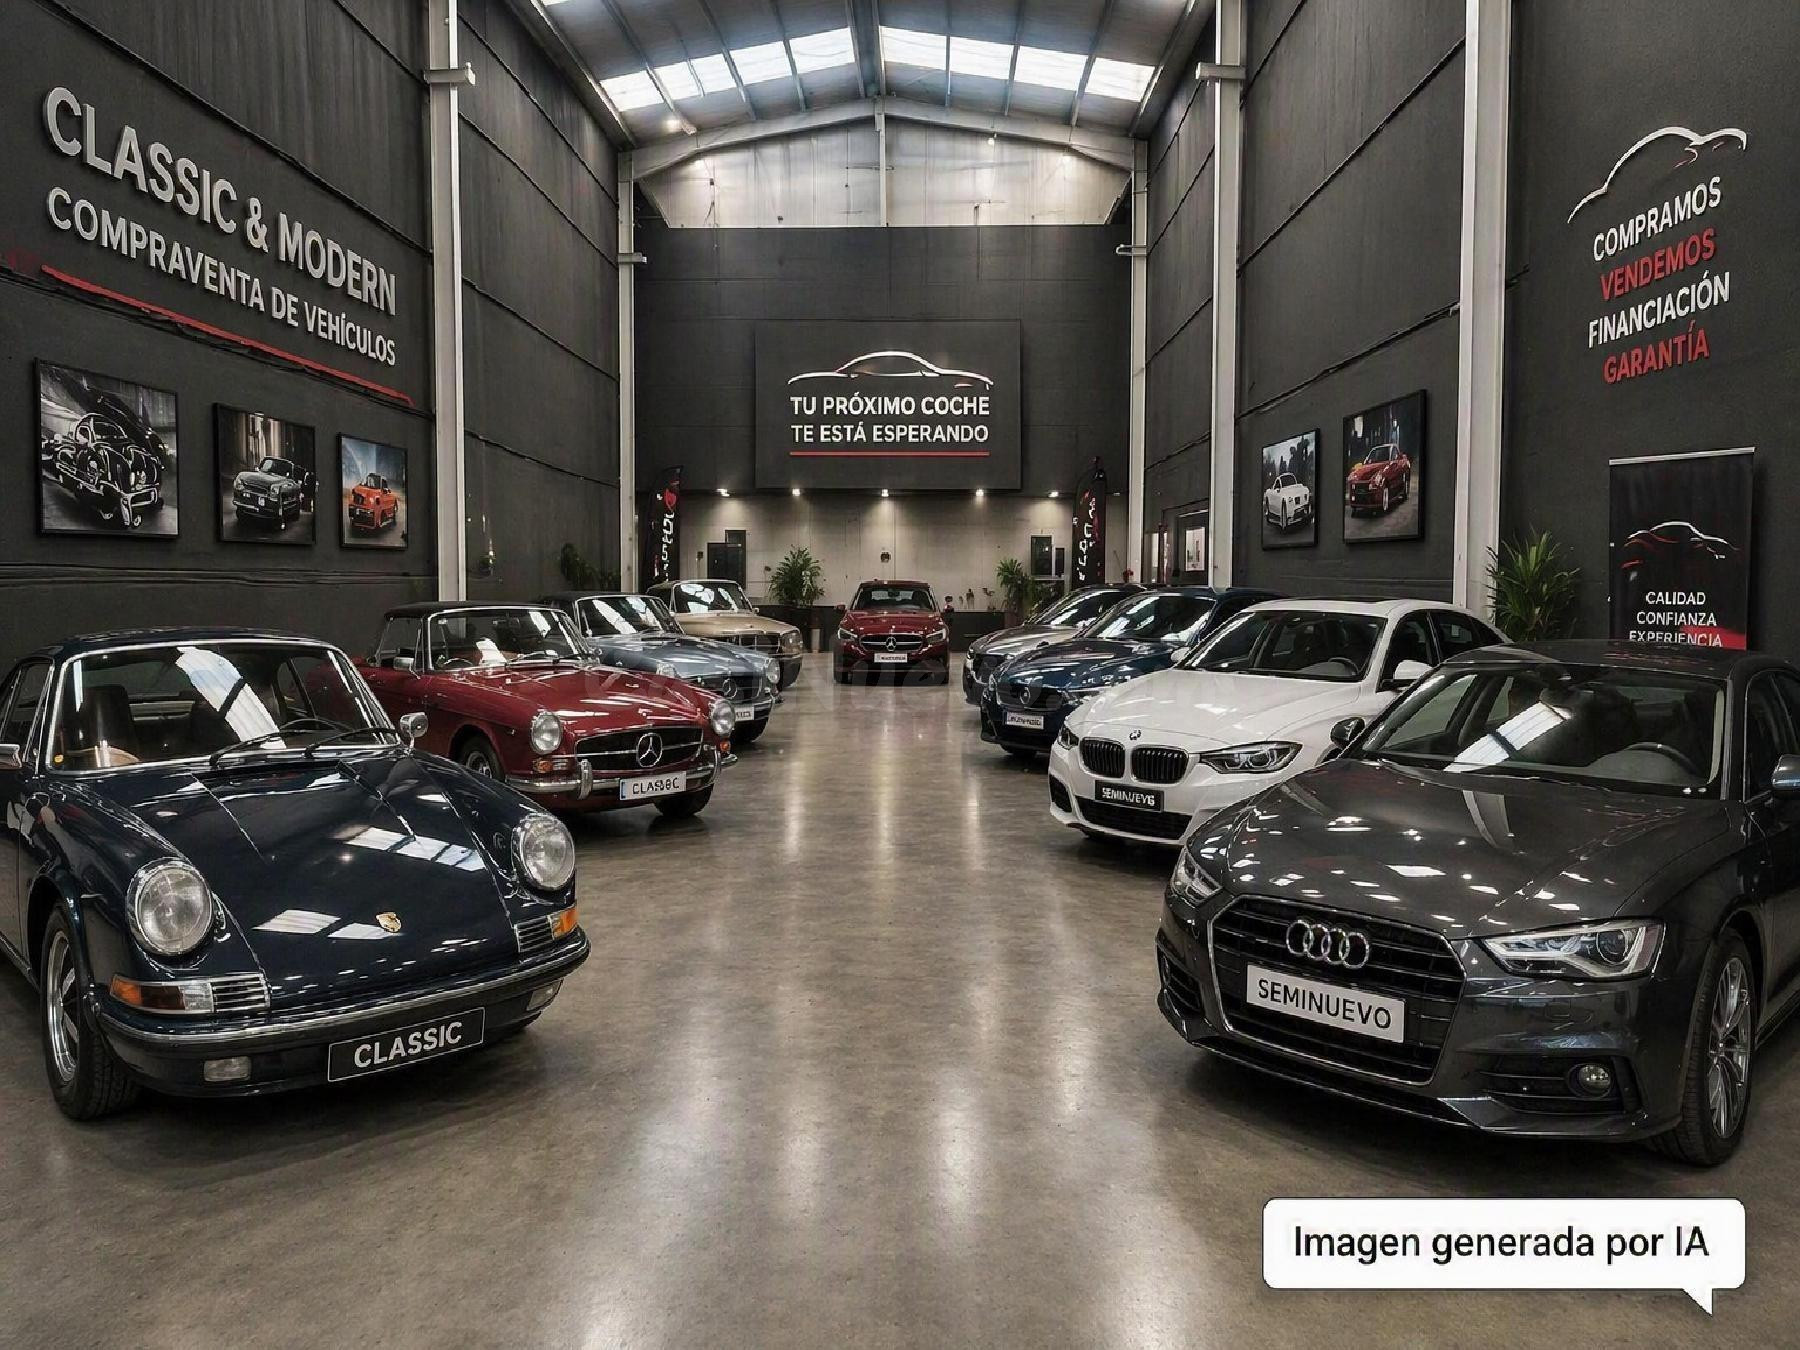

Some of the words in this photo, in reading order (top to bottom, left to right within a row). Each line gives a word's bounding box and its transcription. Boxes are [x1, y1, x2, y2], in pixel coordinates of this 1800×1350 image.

[43, 86, 238, 235] CLASSIC
[245, 197, 269, 253] &
[279, 212, 397, 315] MODERN
[1593, 176, 1721, 262] COMPRAMOS
[47, 187, 265, 312] COMPRAVENTA
[271, 286, 299, 327] DE
[303, 301, 397, 366] VEHÍCULOS
[1600, 227, 1716, 301] VENDEMOS
[1588, 270, 1730, 348] FINANCIACIÓN
[1603, 320, 1710, 385] GARANTÍA
[790, 396, 817, 415] TU
[823, 391, 916, 415] PRÓXIMO
[921, 396, 990, 415] COCHE
[791, 424, 814, 443] TE
[820, 421, 867, 443] ESTÁ
[872, 424, 989, 443] ESPERANDO
[1636, 611, 1717, 627] CONFIANZA
[1645, 591, 1706, 606] CALIDAD
[1629, 630, 1723, 648] EXPERIENCIA
[1258, 978, 1391, 1029] SEMINUEVO
[354, 1021, 462, 1068] CLASSIC
